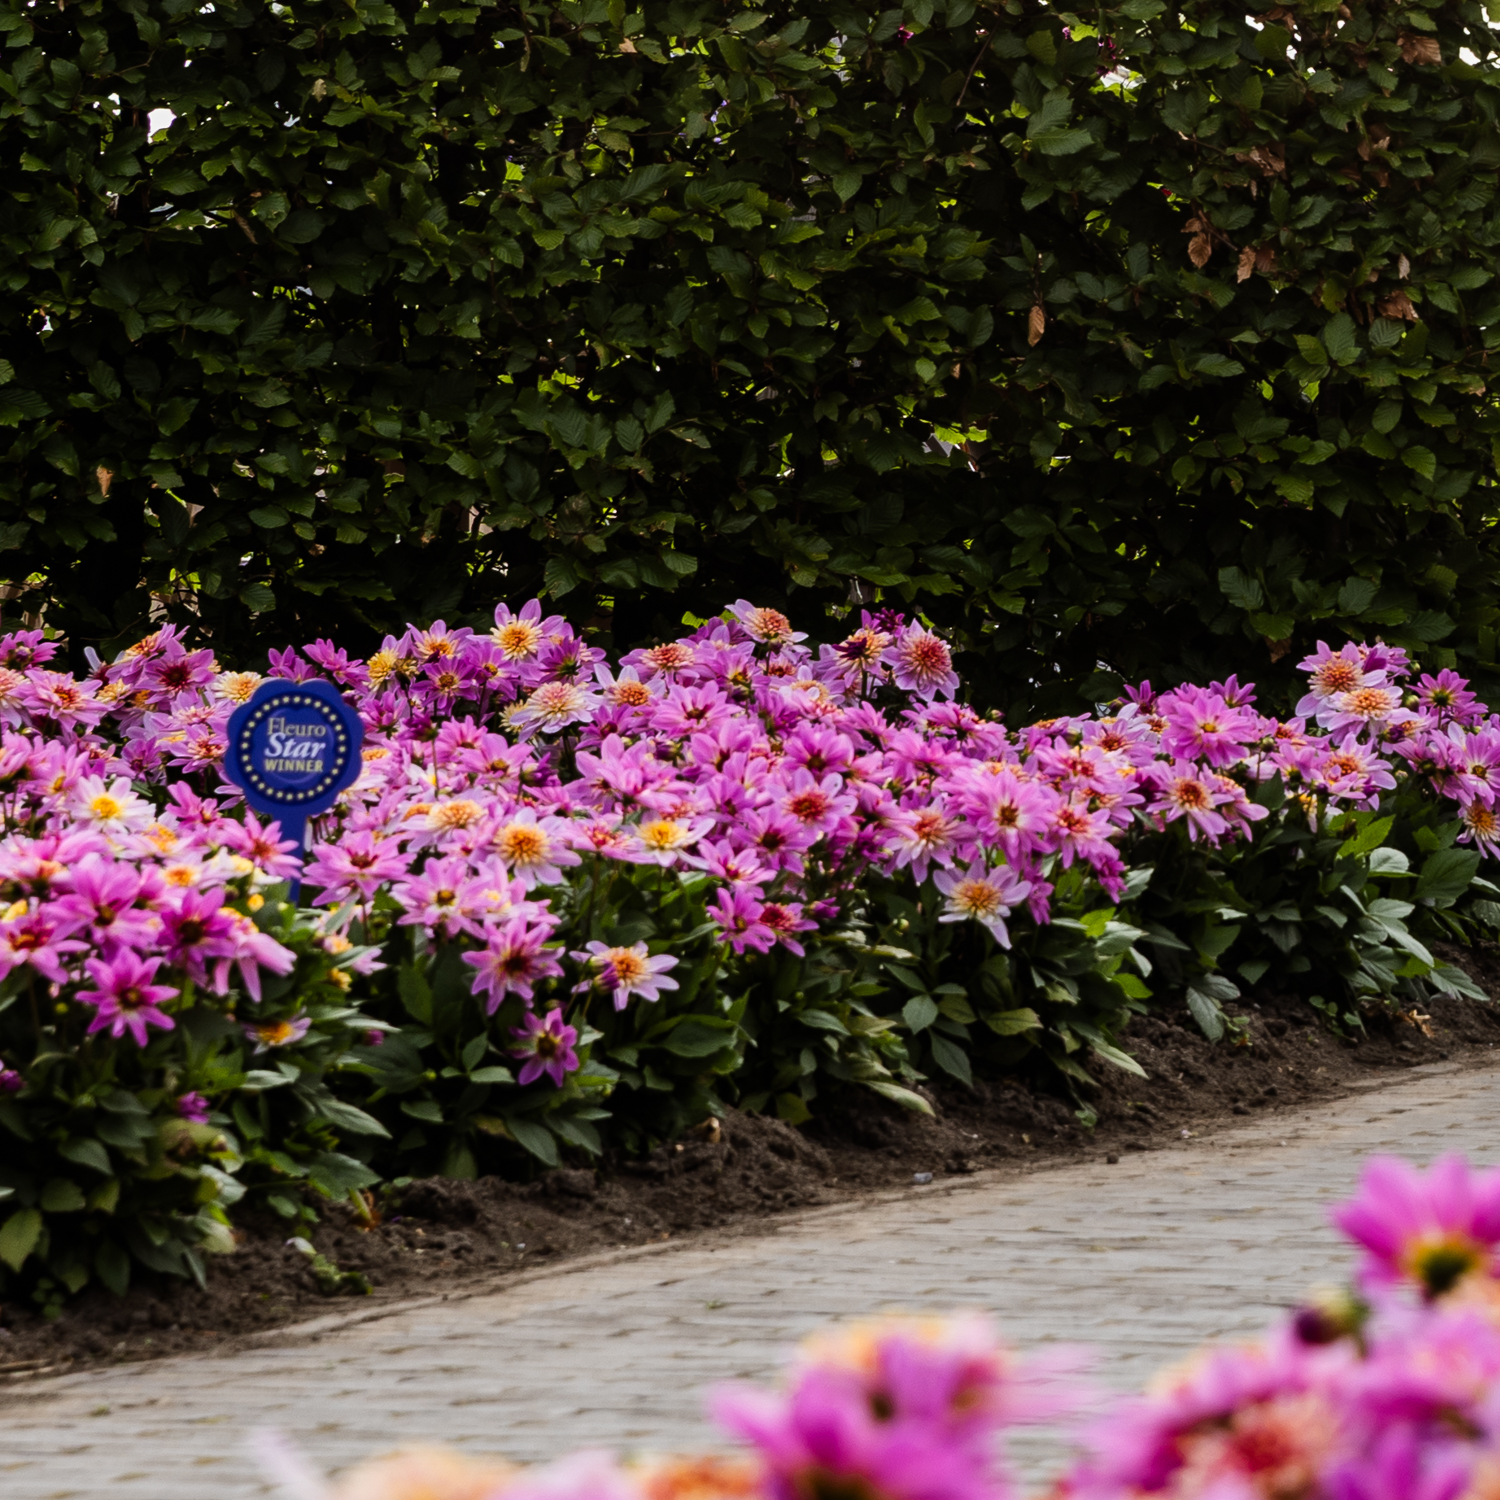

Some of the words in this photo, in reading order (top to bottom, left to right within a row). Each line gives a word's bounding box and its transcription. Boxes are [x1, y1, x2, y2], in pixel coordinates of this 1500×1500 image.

[267, 716, 326, 737] Fleuro
[264, 732, 326, 758] Star
[264, 759, 323, 773] WINNER
